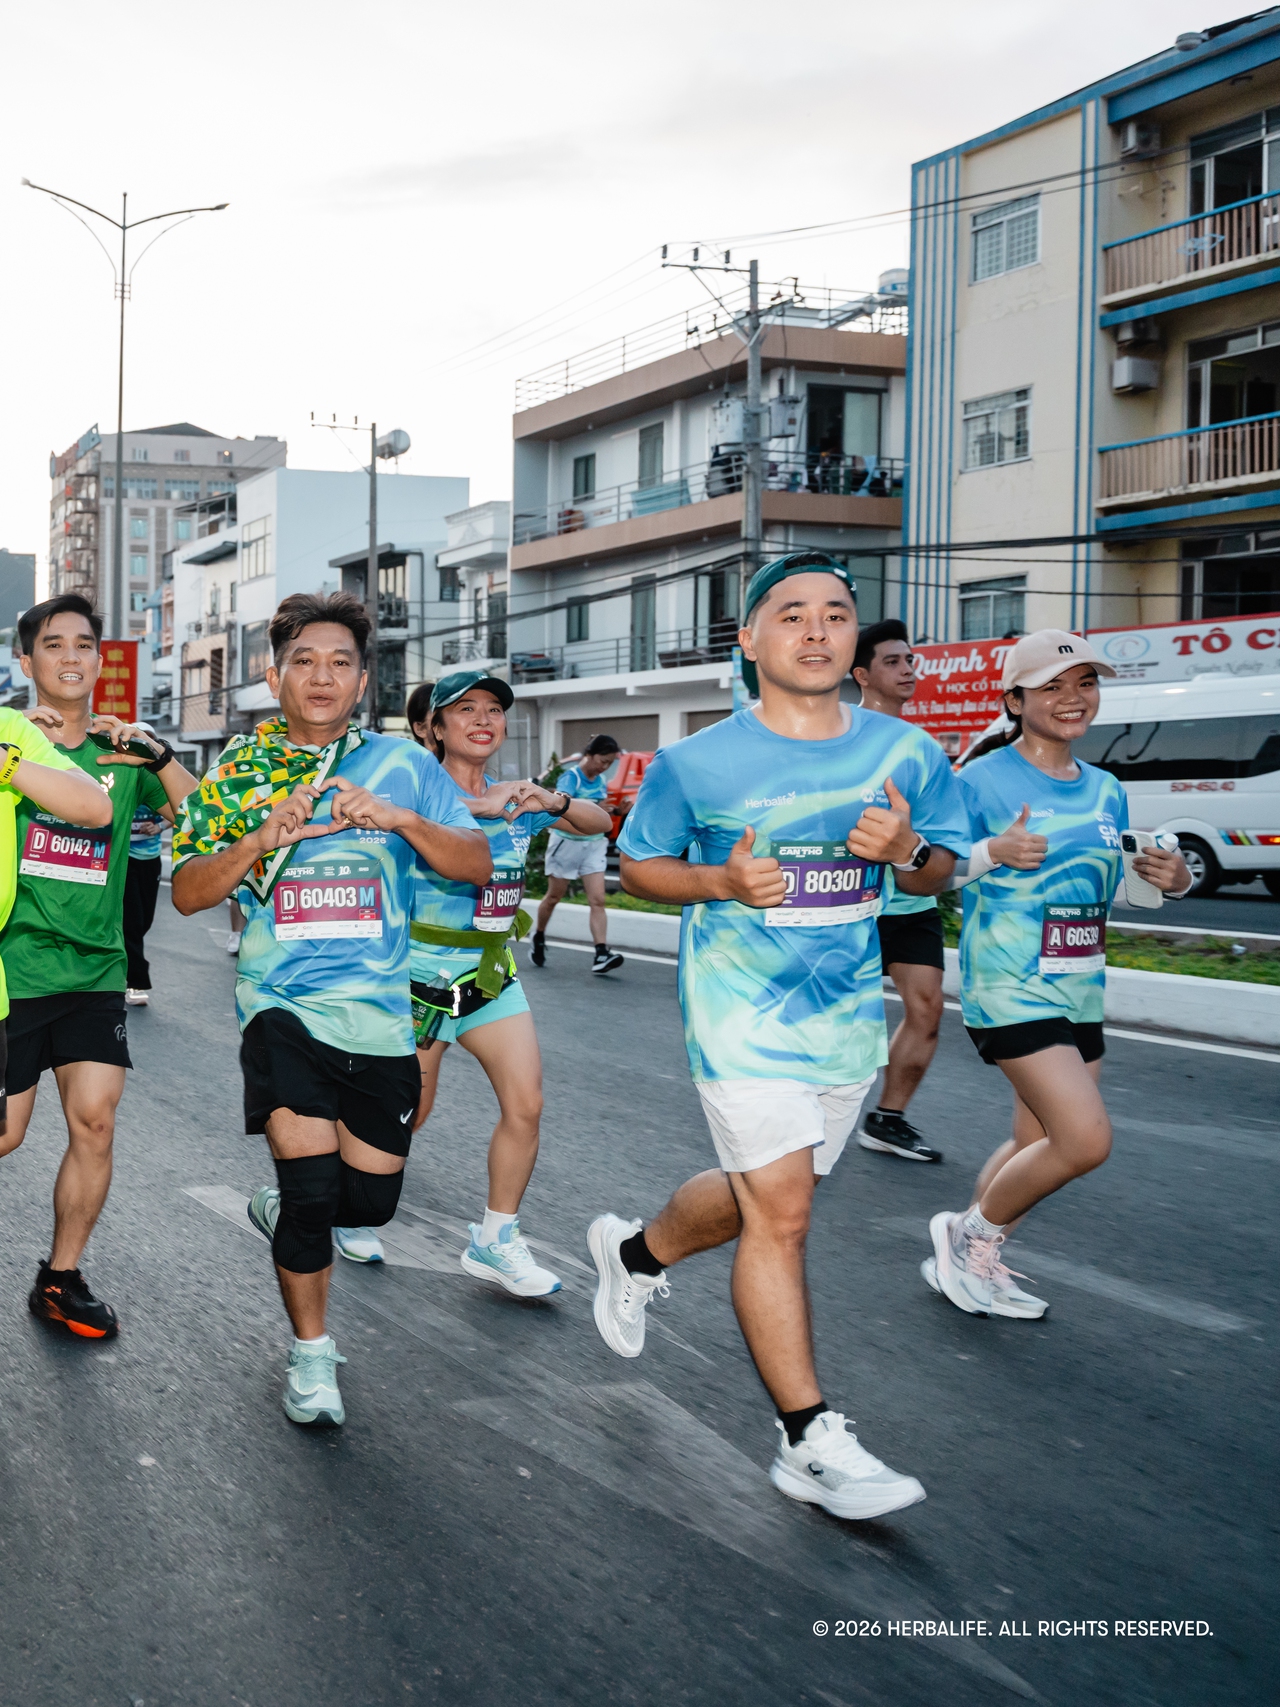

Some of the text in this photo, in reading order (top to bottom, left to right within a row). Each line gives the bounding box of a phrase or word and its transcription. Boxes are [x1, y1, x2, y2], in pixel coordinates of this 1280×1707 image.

[1172, 627, 1280, 656] TÔ C
[913, 648, 987, 681] Quỳnh
[745, 795, 793, 808] Herbalife
[33, 832, 106, 858] D 60142 M
[805, 868, 862, 893] 80301
[864, 865, 879, 888] M
[283, 886, 375, 910] D 60403 M
[484, 890, 493, 907] D
[1049, 926, 1061, 946] A
